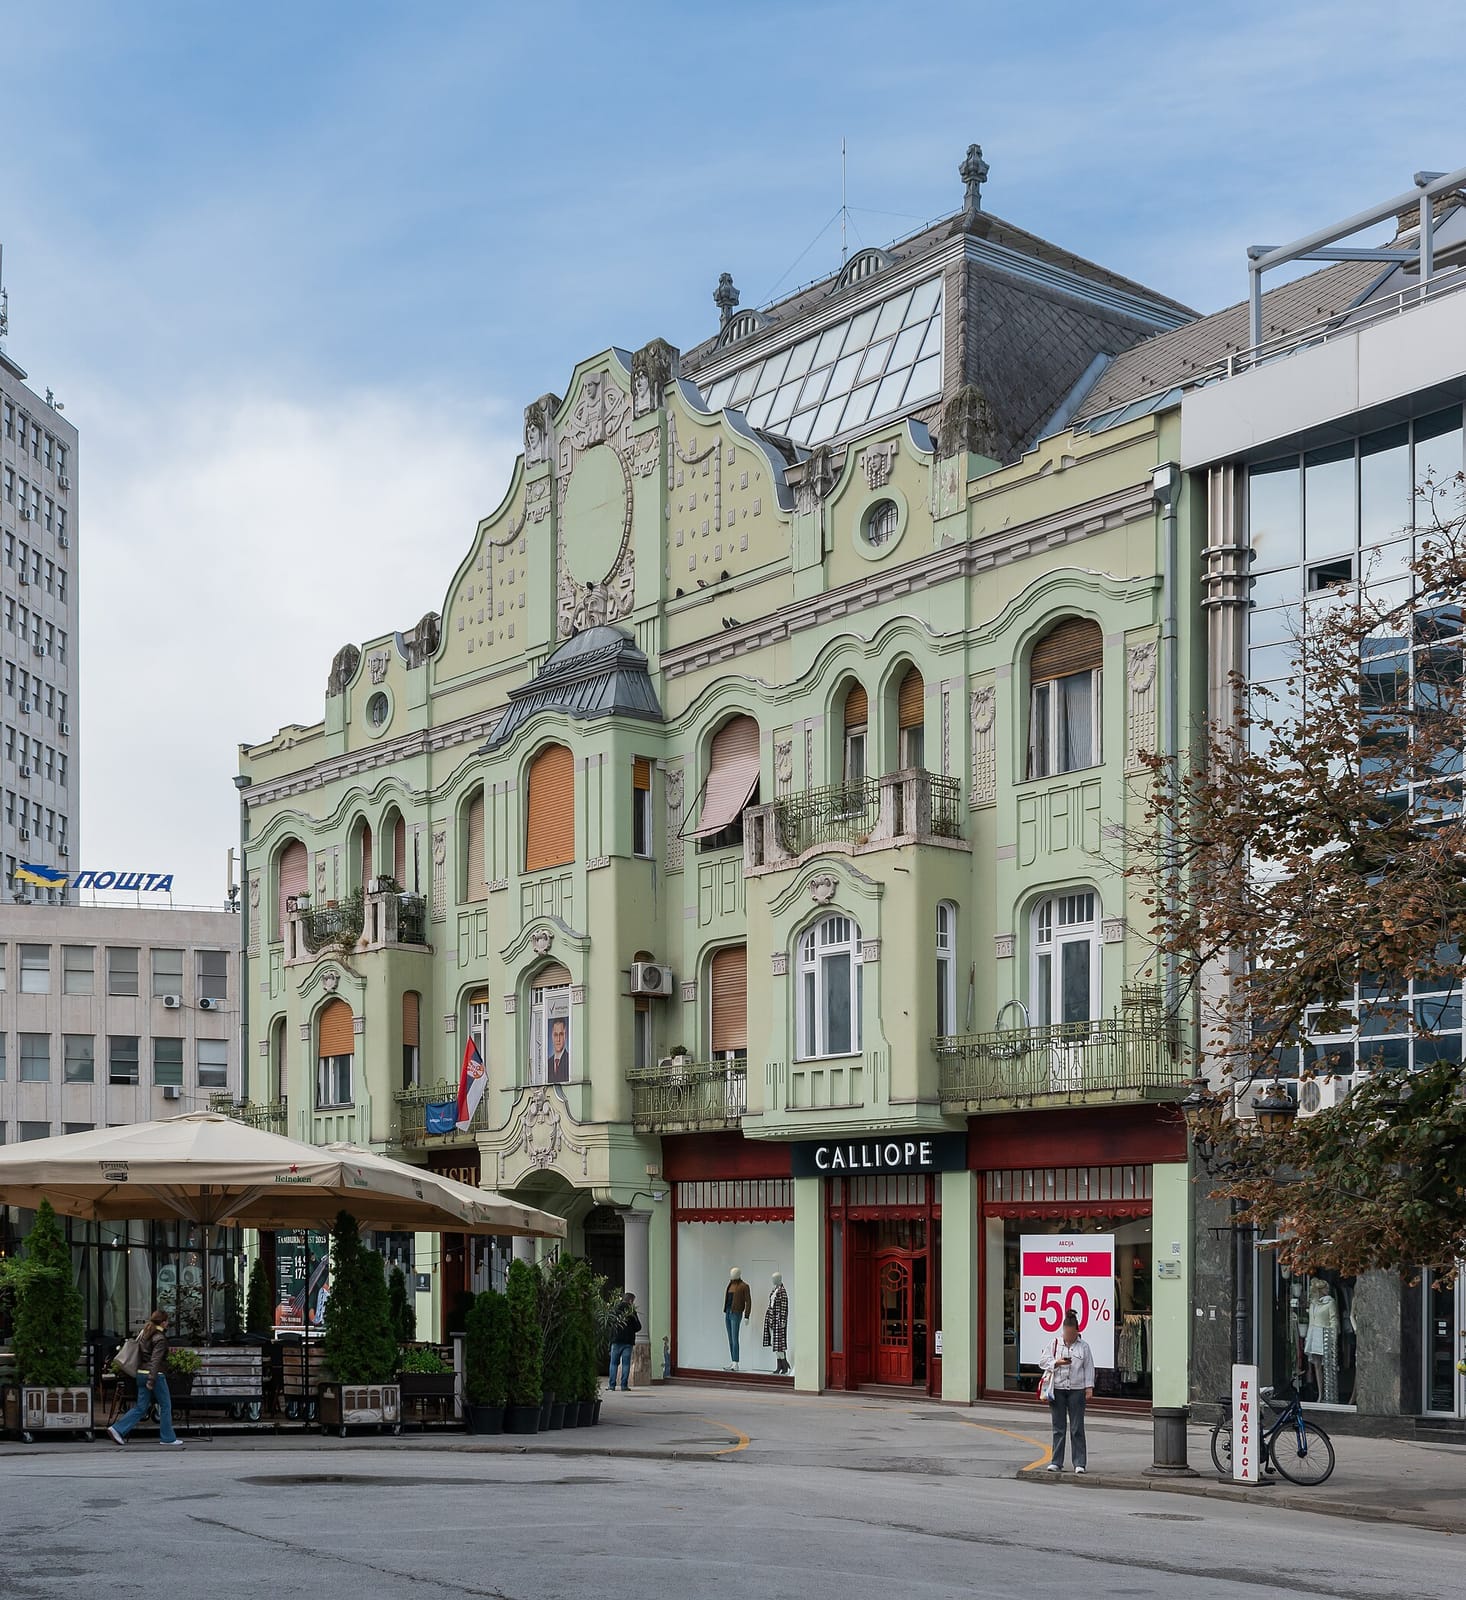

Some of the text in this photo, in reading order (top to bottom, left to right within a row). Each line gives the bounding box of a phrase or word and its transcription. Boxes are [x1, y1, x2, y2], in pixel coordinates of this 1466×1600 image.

[72, 871, 175, 892] ПОШТА
[815, 1141, 932, 1169] CALLIOPE
[275, 1175, 311, 1183] Heineken
[1024, 1292, 1036, 1301] DO
[1239, 1380, 1250, 1478] MENJAČNICA
